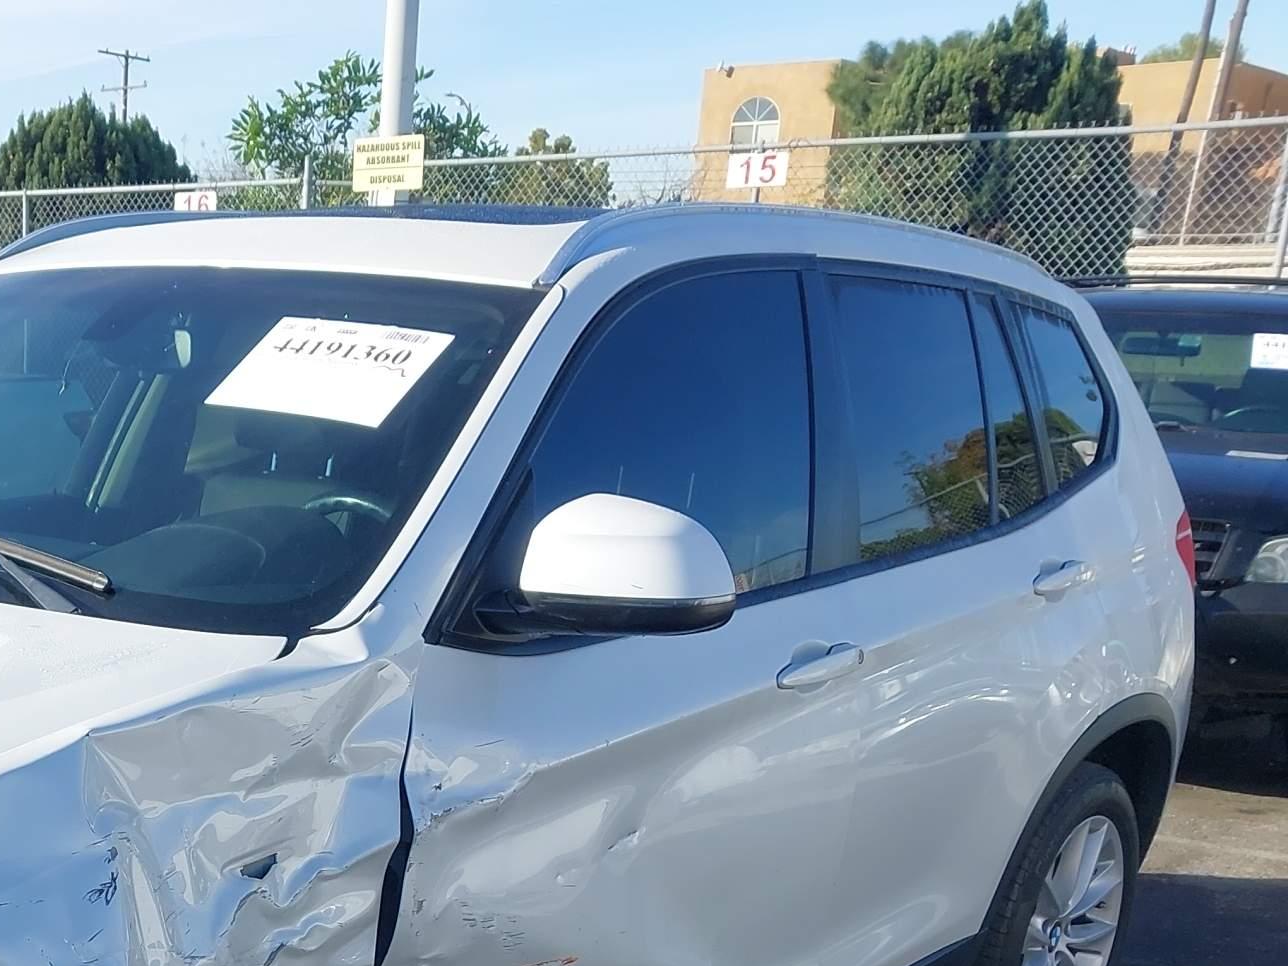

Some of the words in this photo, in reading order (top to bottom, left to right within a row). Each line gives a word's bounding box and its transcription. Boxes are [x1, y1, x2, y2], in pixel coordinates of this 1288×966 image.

[356, 142, 400, 153] HAZARDOUS
[402, 141, 421, 151] SPILL
[740, 155, 777, 185] 15
[370, 174, 405, 185] DISPOSAL
[184, 194, 209, 211] 16
[273, 337, 413, 366] 44191360
